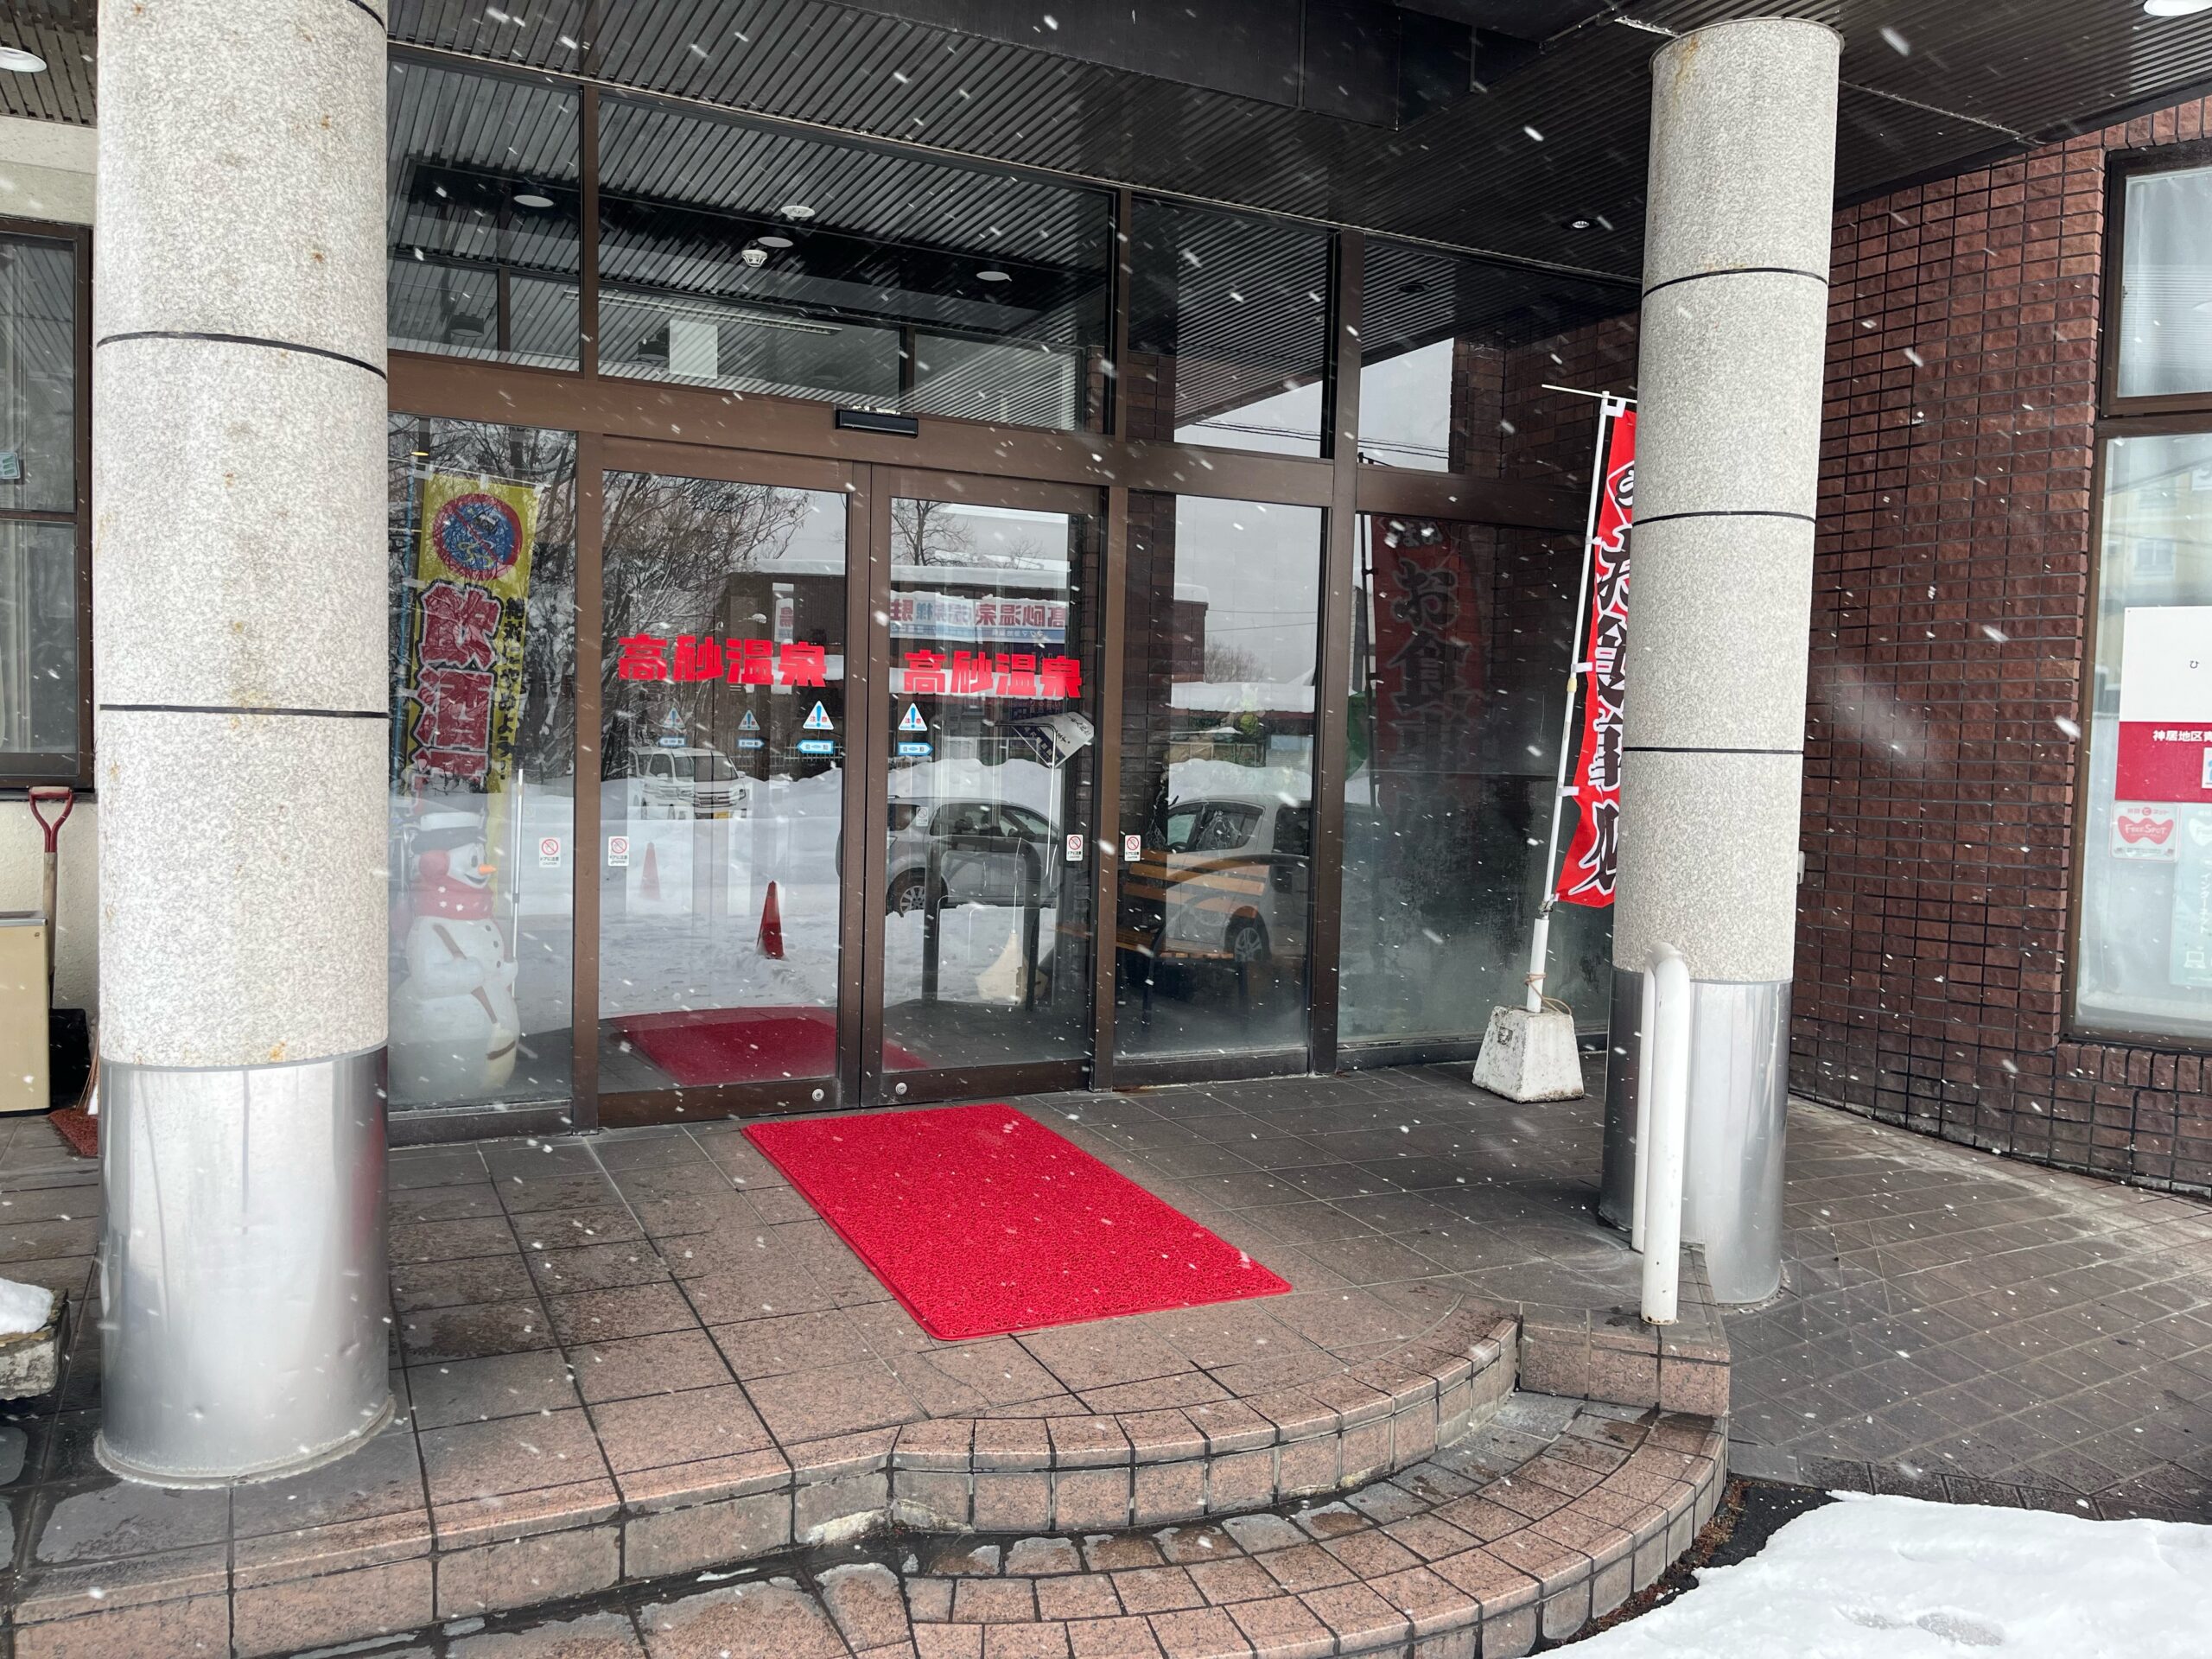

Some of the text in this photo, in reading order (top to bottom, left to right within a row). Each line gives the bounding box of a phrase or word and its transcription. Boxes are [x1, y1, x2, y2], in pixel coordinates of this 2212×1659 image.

[618, 633, 828, 688] 高砂温泉
[904, 649, 1084, 698] 高砂温泉
